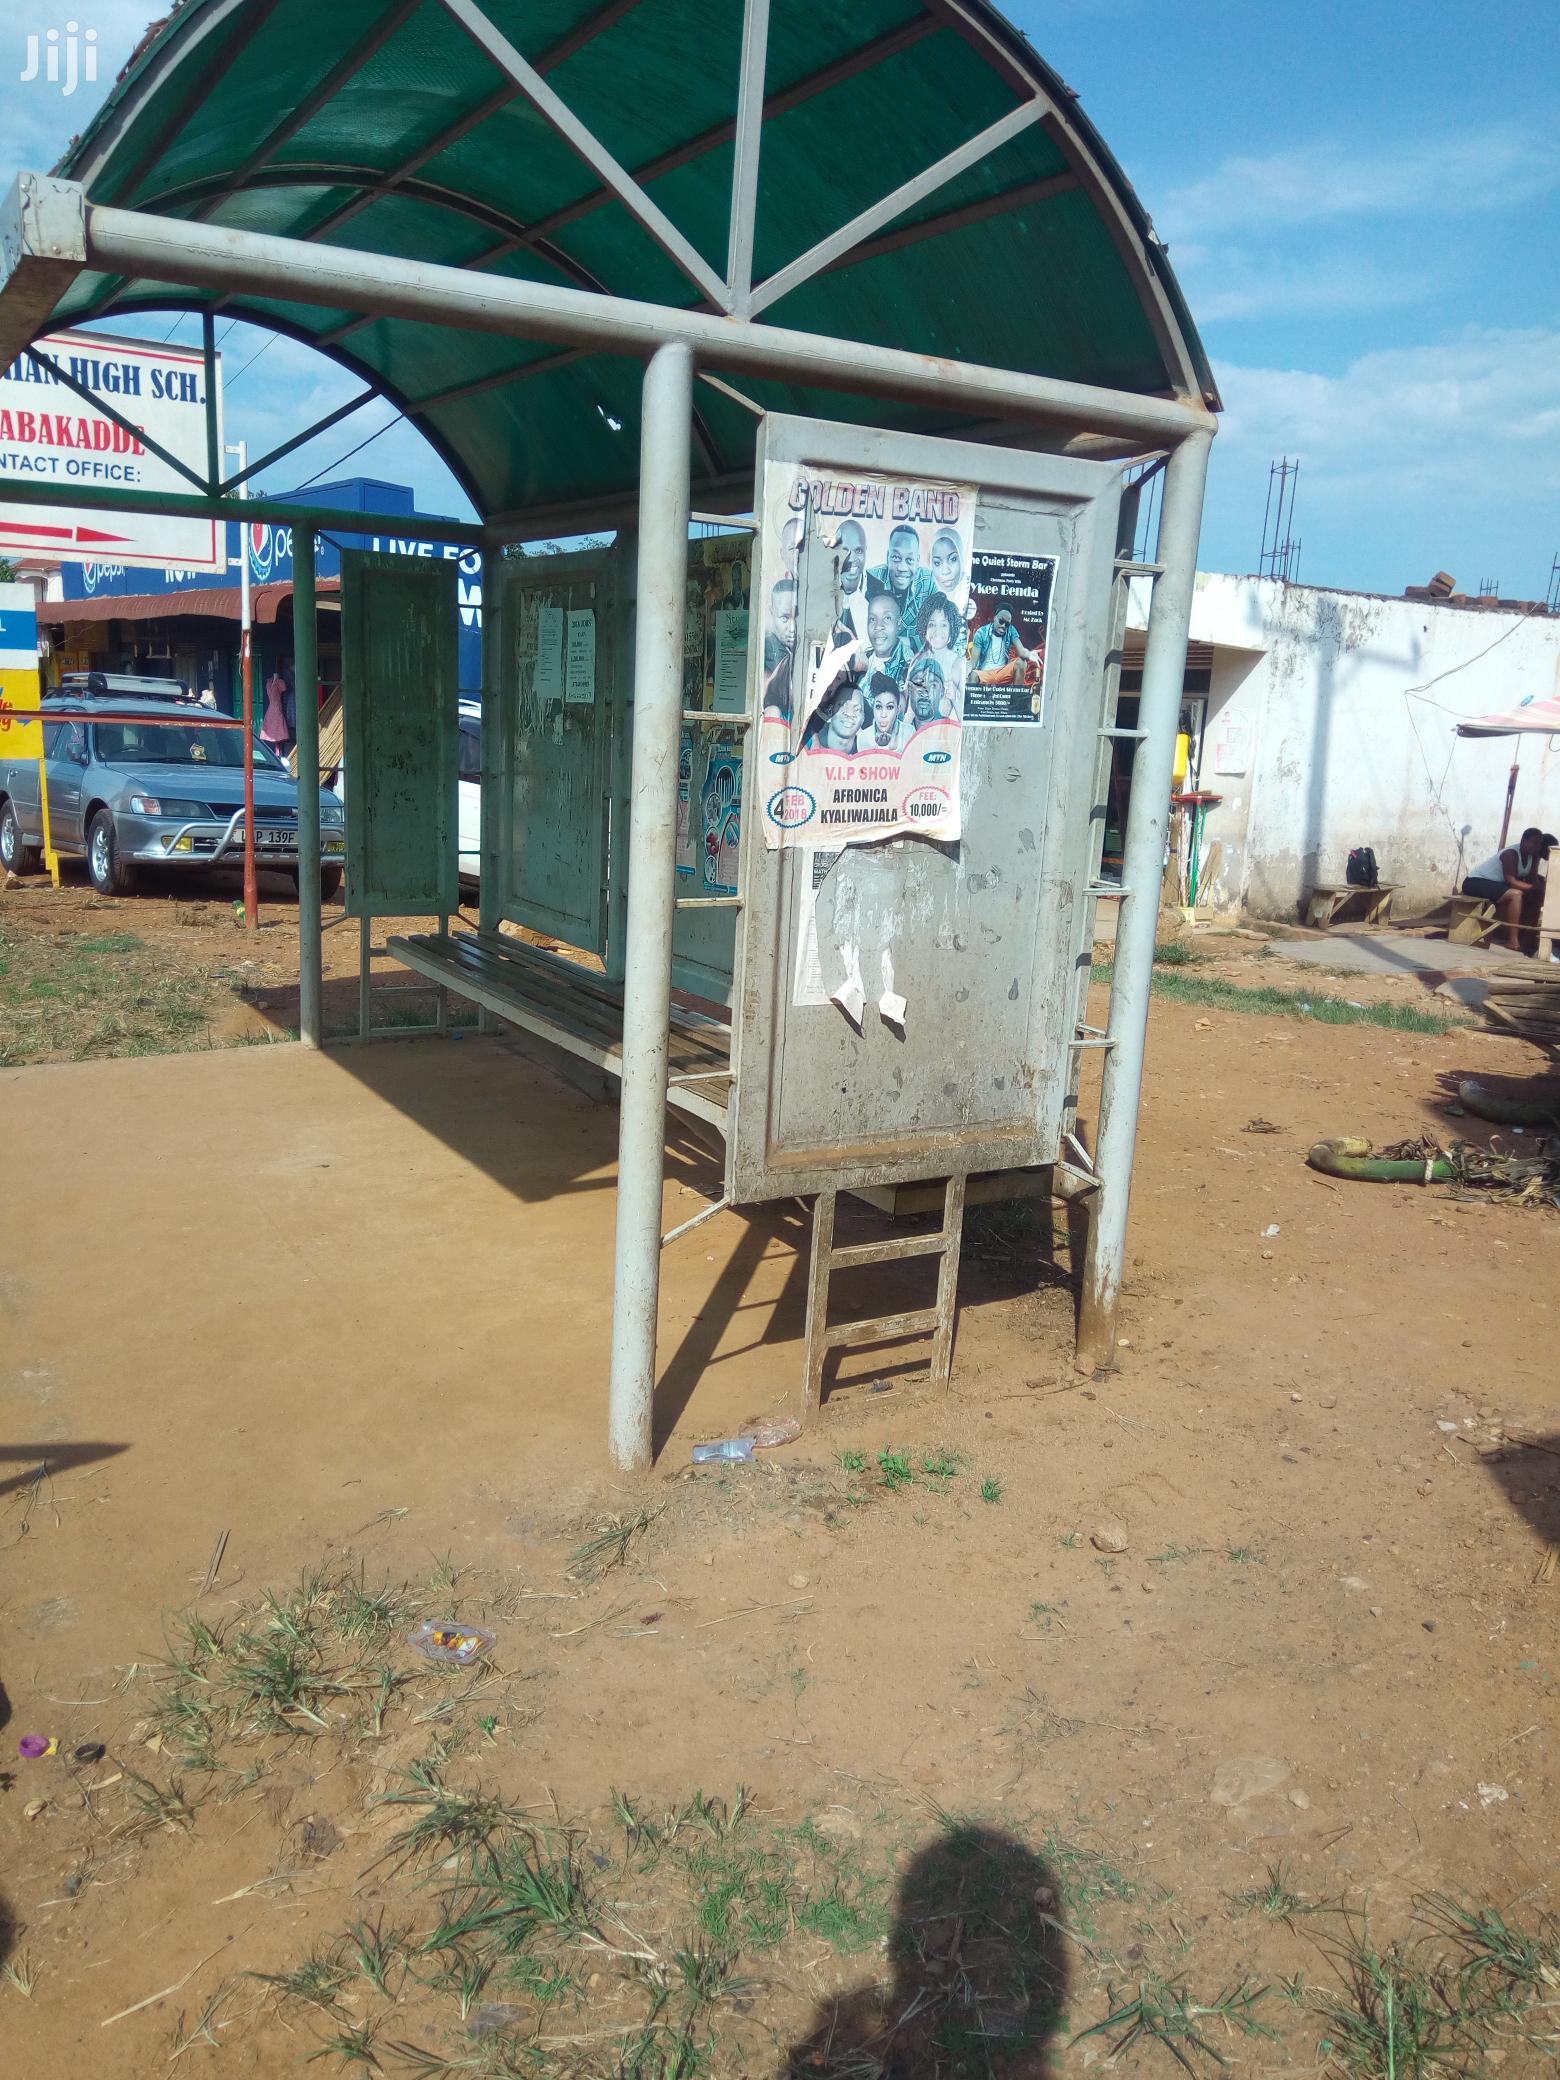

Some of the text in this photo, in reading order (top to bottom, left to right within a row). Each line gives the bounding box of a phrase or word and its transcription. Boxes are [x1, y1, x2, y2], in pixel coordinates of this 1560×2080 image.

[69, 356, 142, 396] HIGH
[150, 368, 207, 404] SCH.
[66, 459, 141, 482] OFFICE:
[892, 487, 961, 525] BAND
[982, 555, 1005, 567] Quiet
[1007, 557, 1030, 569] Storm
[1032, 560, 1048, 570] Bar
[928, 753, 948, 763] MTN
[825, 766, 901, 781] V.I.P SHOW
[833, 788, 888, 804] AFRONICA
[919, 792, 937, 801] FEE:
[773, 798, 784, 819] 4
[820, 808, 898, 824] KYALIWAJJALA
[910, 803, 948, 818] 10,000/=
